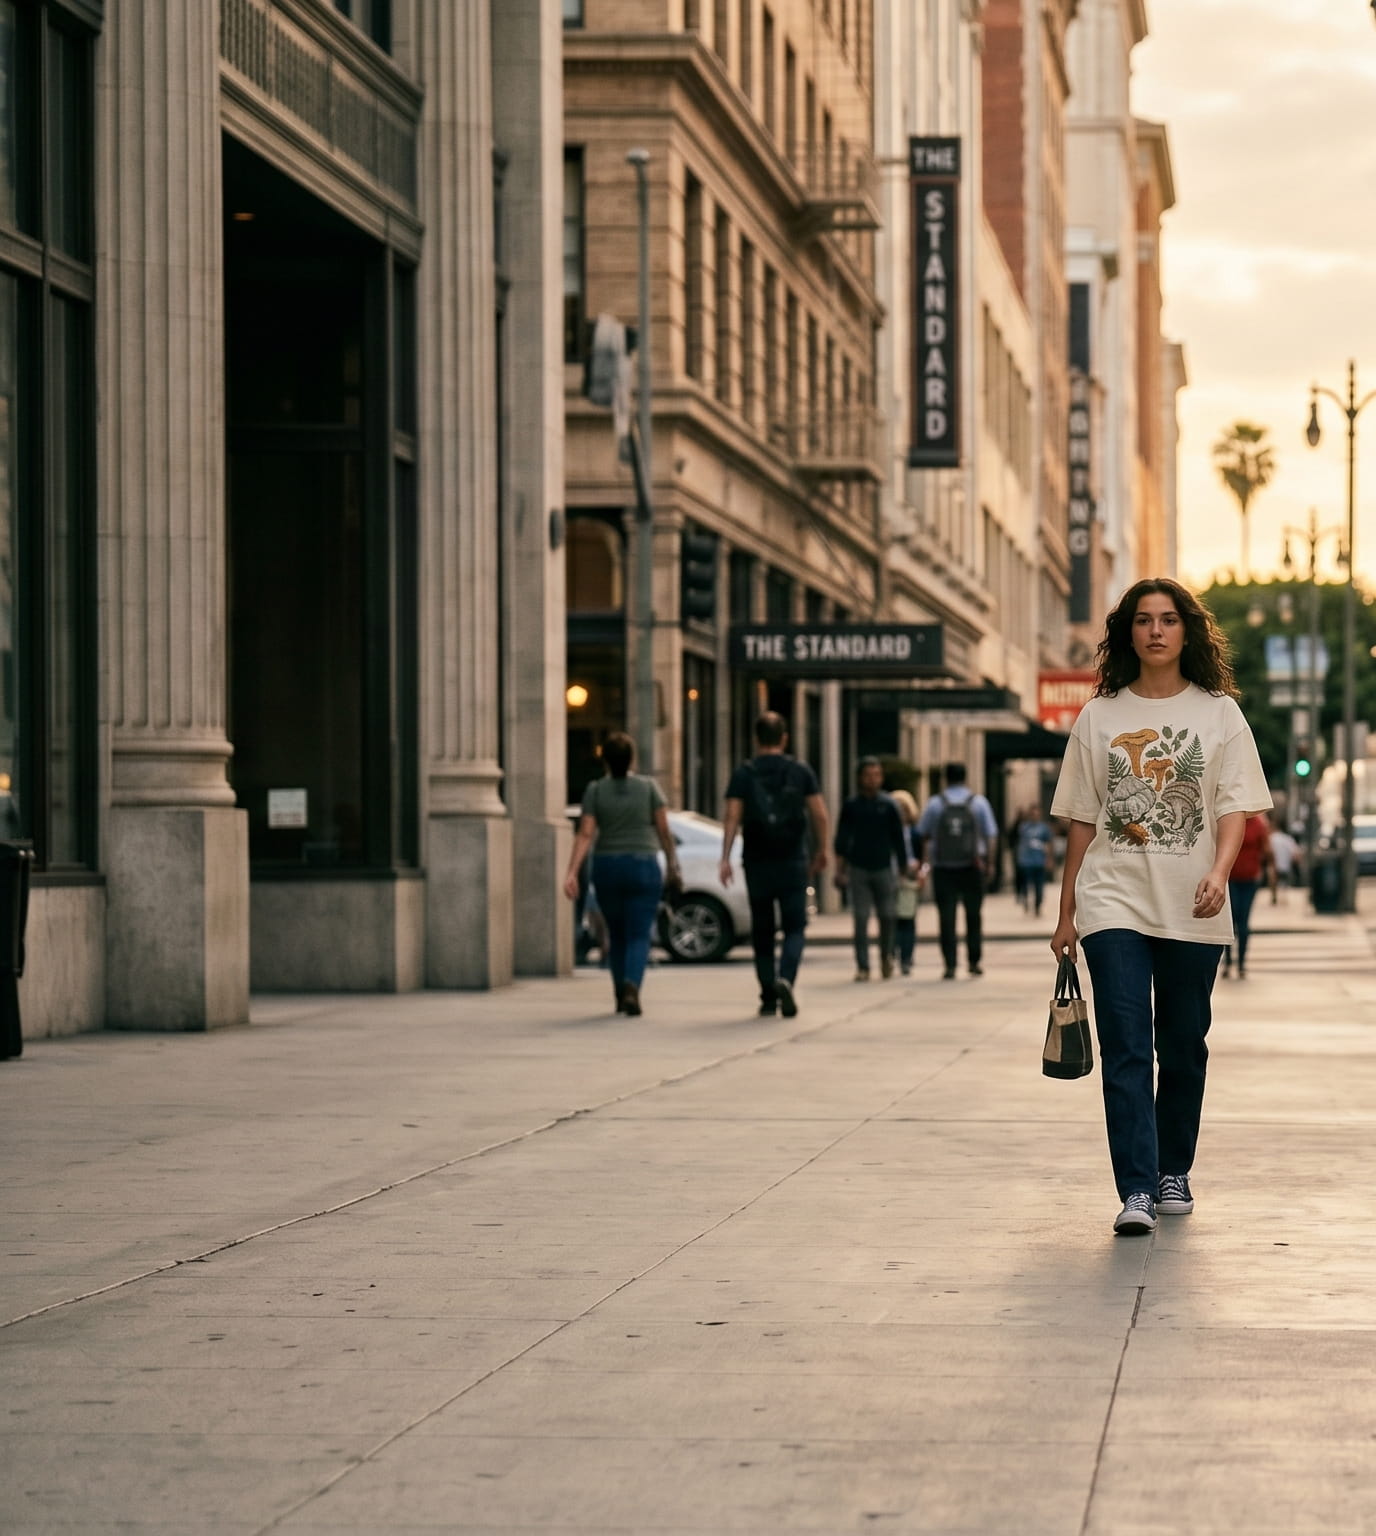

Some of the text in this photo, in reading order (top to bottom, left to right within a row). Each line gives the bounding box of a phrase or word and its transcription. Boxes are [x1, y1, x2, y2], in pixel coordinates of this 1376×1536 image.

[913, 147, 954, 170] THE
[924, 190, 946, 440] STANDARD
[743, 634, 911, 661] THE STANDARD
